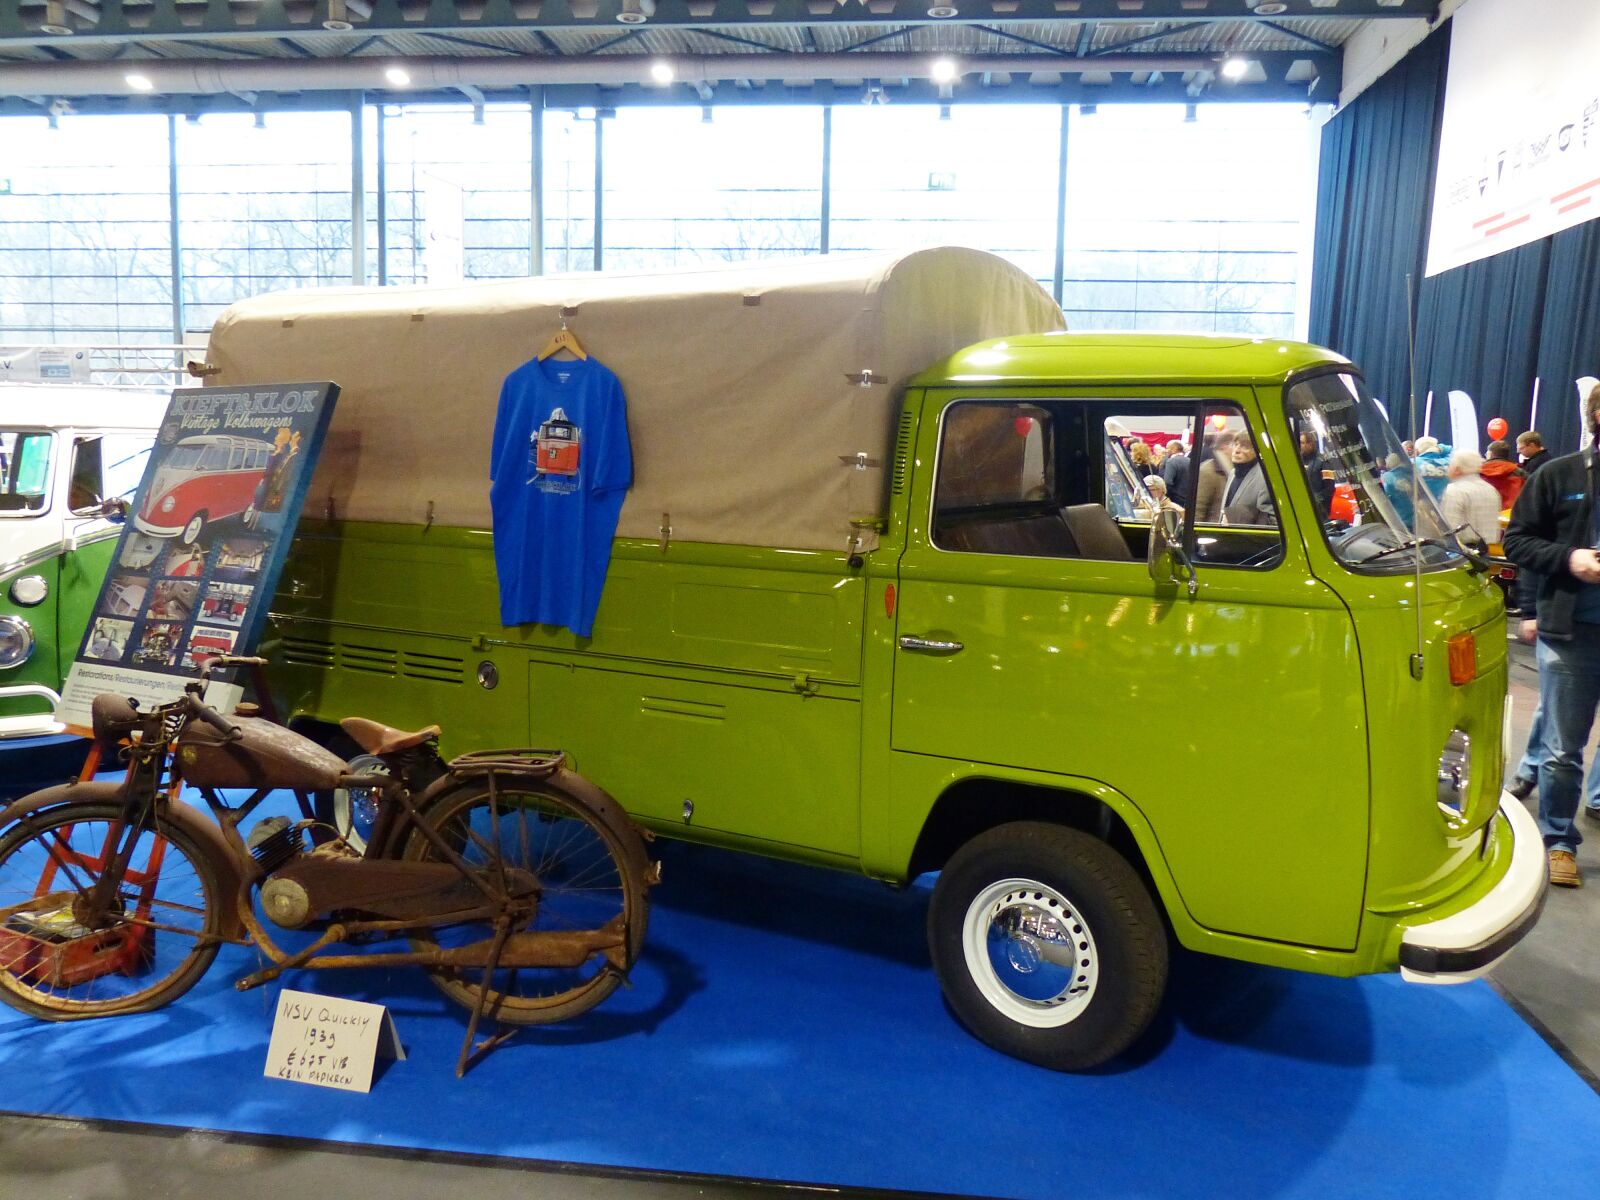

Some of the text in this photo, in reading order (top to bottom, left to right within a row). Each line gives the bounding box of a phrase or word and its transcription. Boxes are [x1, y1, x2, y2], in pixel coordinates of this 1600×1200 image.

[180, 411, 293, 434] Vintage Volkswagens
[304, 1026, 336, 1049] 1939
